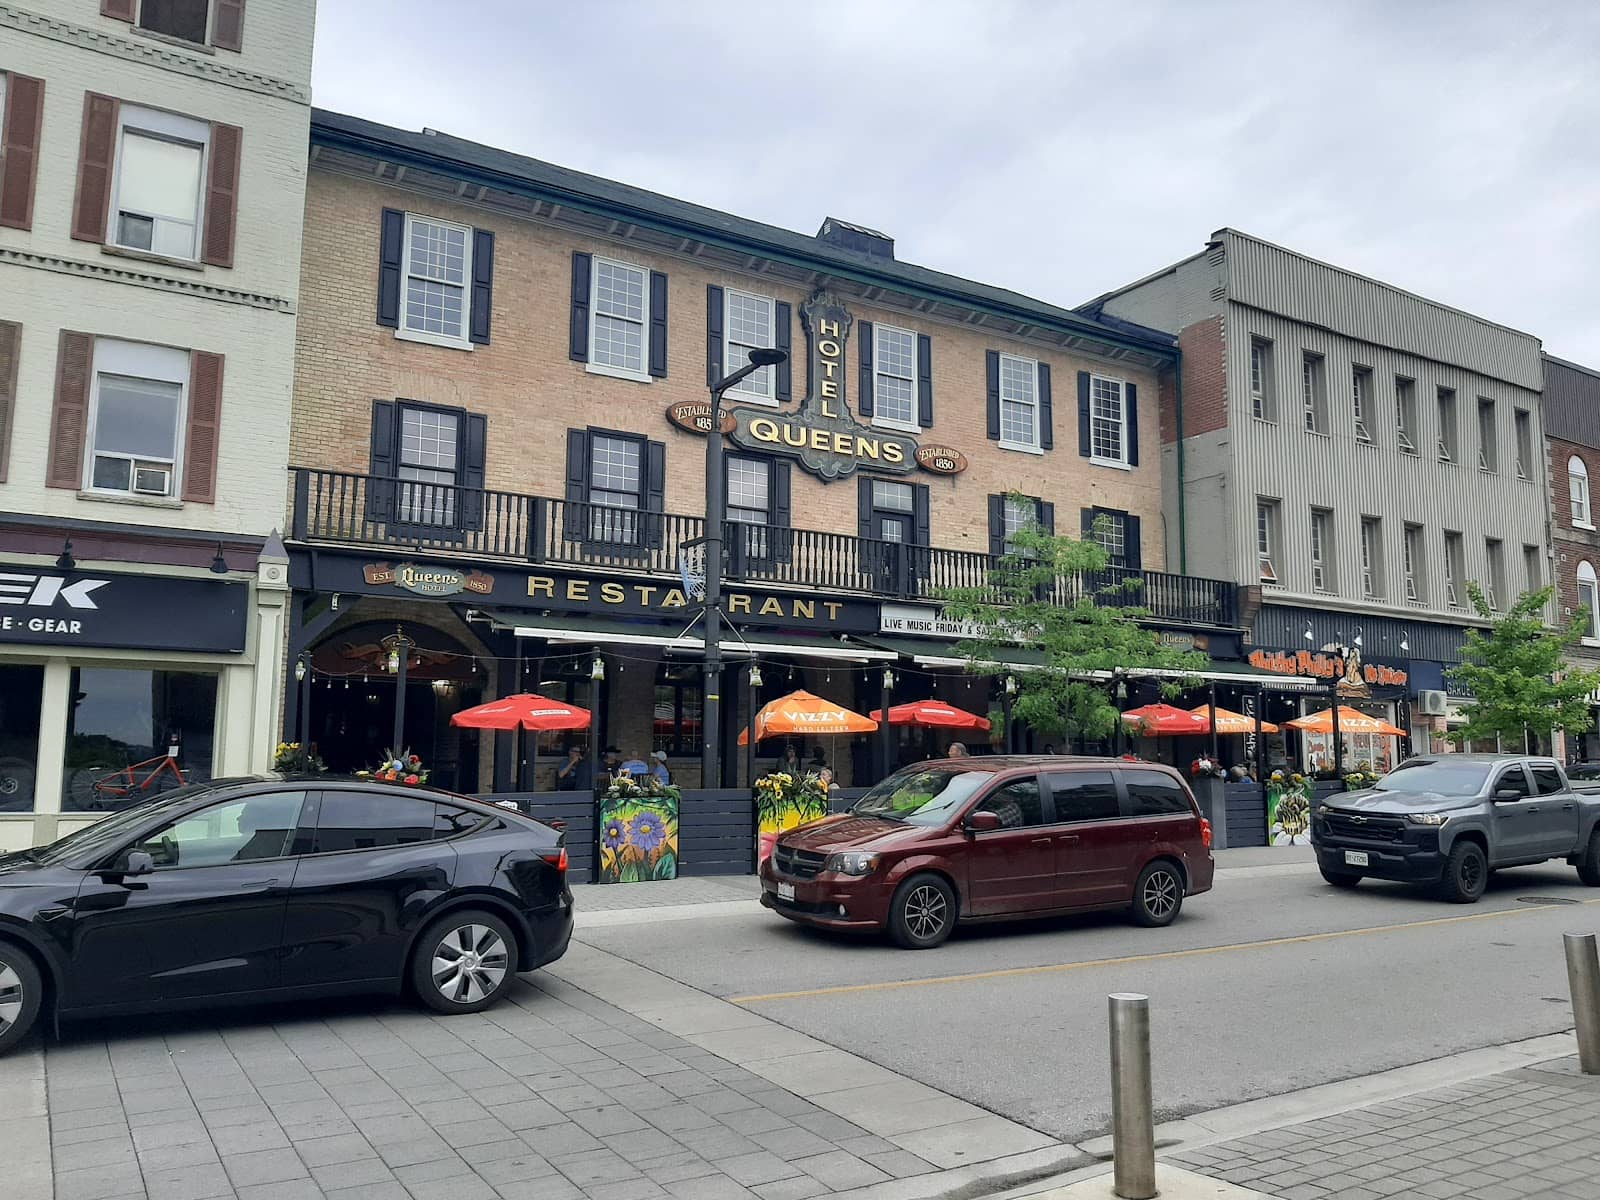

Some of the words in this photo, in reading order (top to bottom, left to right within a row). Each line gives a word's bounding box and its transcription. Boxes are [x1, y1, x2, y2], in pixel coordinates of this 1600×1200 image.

[818, 318, 841, 418] HOTEL
[675, 405, 728, 420] ESTABLISED
[696, 417, 713, 431] 185
[750, 418, 904, 463] QUEENS
[919, 447, 960, 461] ESTABLISHED
[935, 458, 954, 470] 1850
[401, 567, 459, 587] Queens
[470, 579, 487, 591] 1850
[421, 584, 447, 593] HOTEL
[527, 575, 844, 621] RESTARANT
[28, 618, 81, 634] GEAR
[884, 619, 903, 630] LIVE
[907, 620, 932, 632] MUSIC
[935, 623, 964, 634] FRIDAY
[967, 625, 973, 635] &
[784, 711, 846, 722] VIZZY
